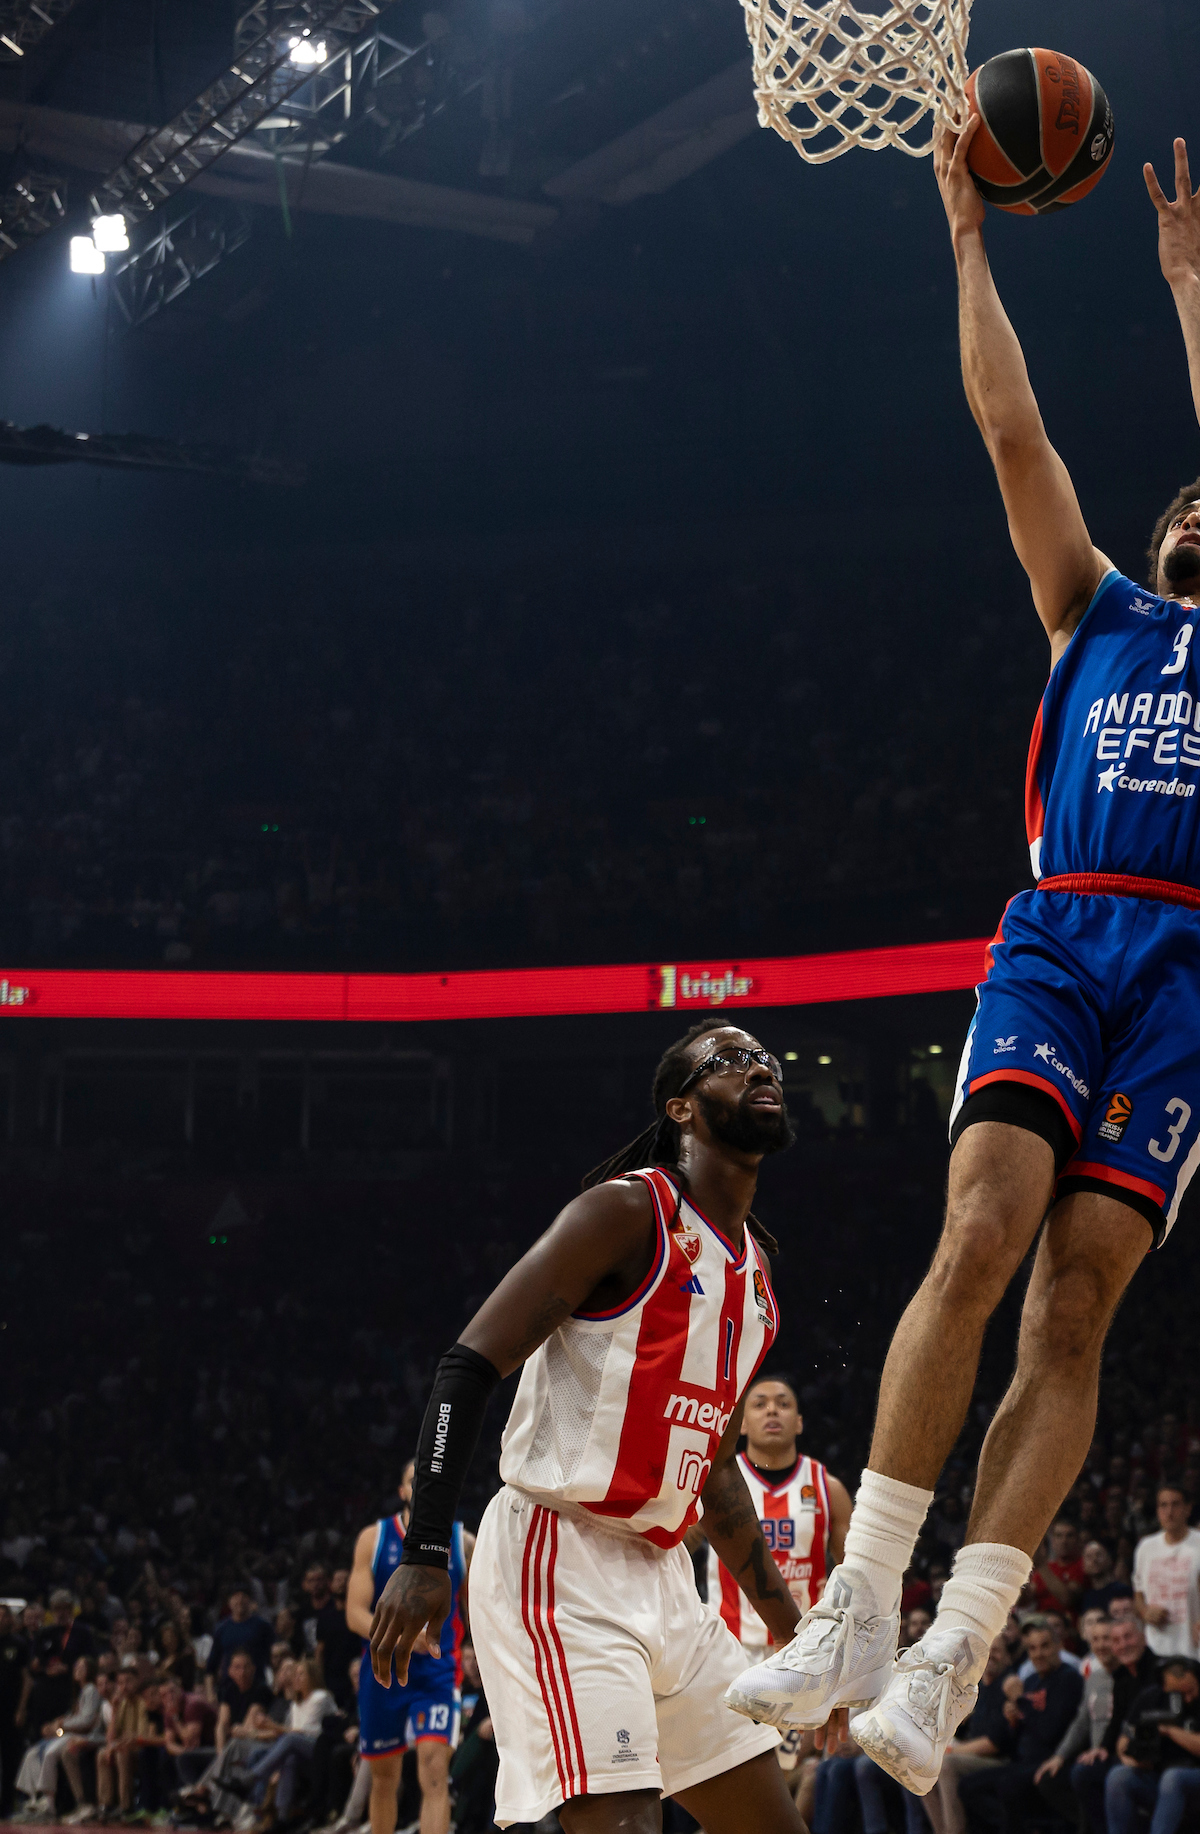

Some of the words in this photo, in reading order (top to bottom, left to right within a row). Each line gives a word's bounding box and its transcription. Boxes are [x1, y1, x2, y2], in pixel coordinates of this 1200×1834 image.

[1161, 622, 1194, 675] 3
[1117, 774, 1196, 798] corendon
[1148, 1097, 1192, 1163] 3
[432, 1402, 452, 1459] BROWN
[429, 1703, 450, 1731] 13
